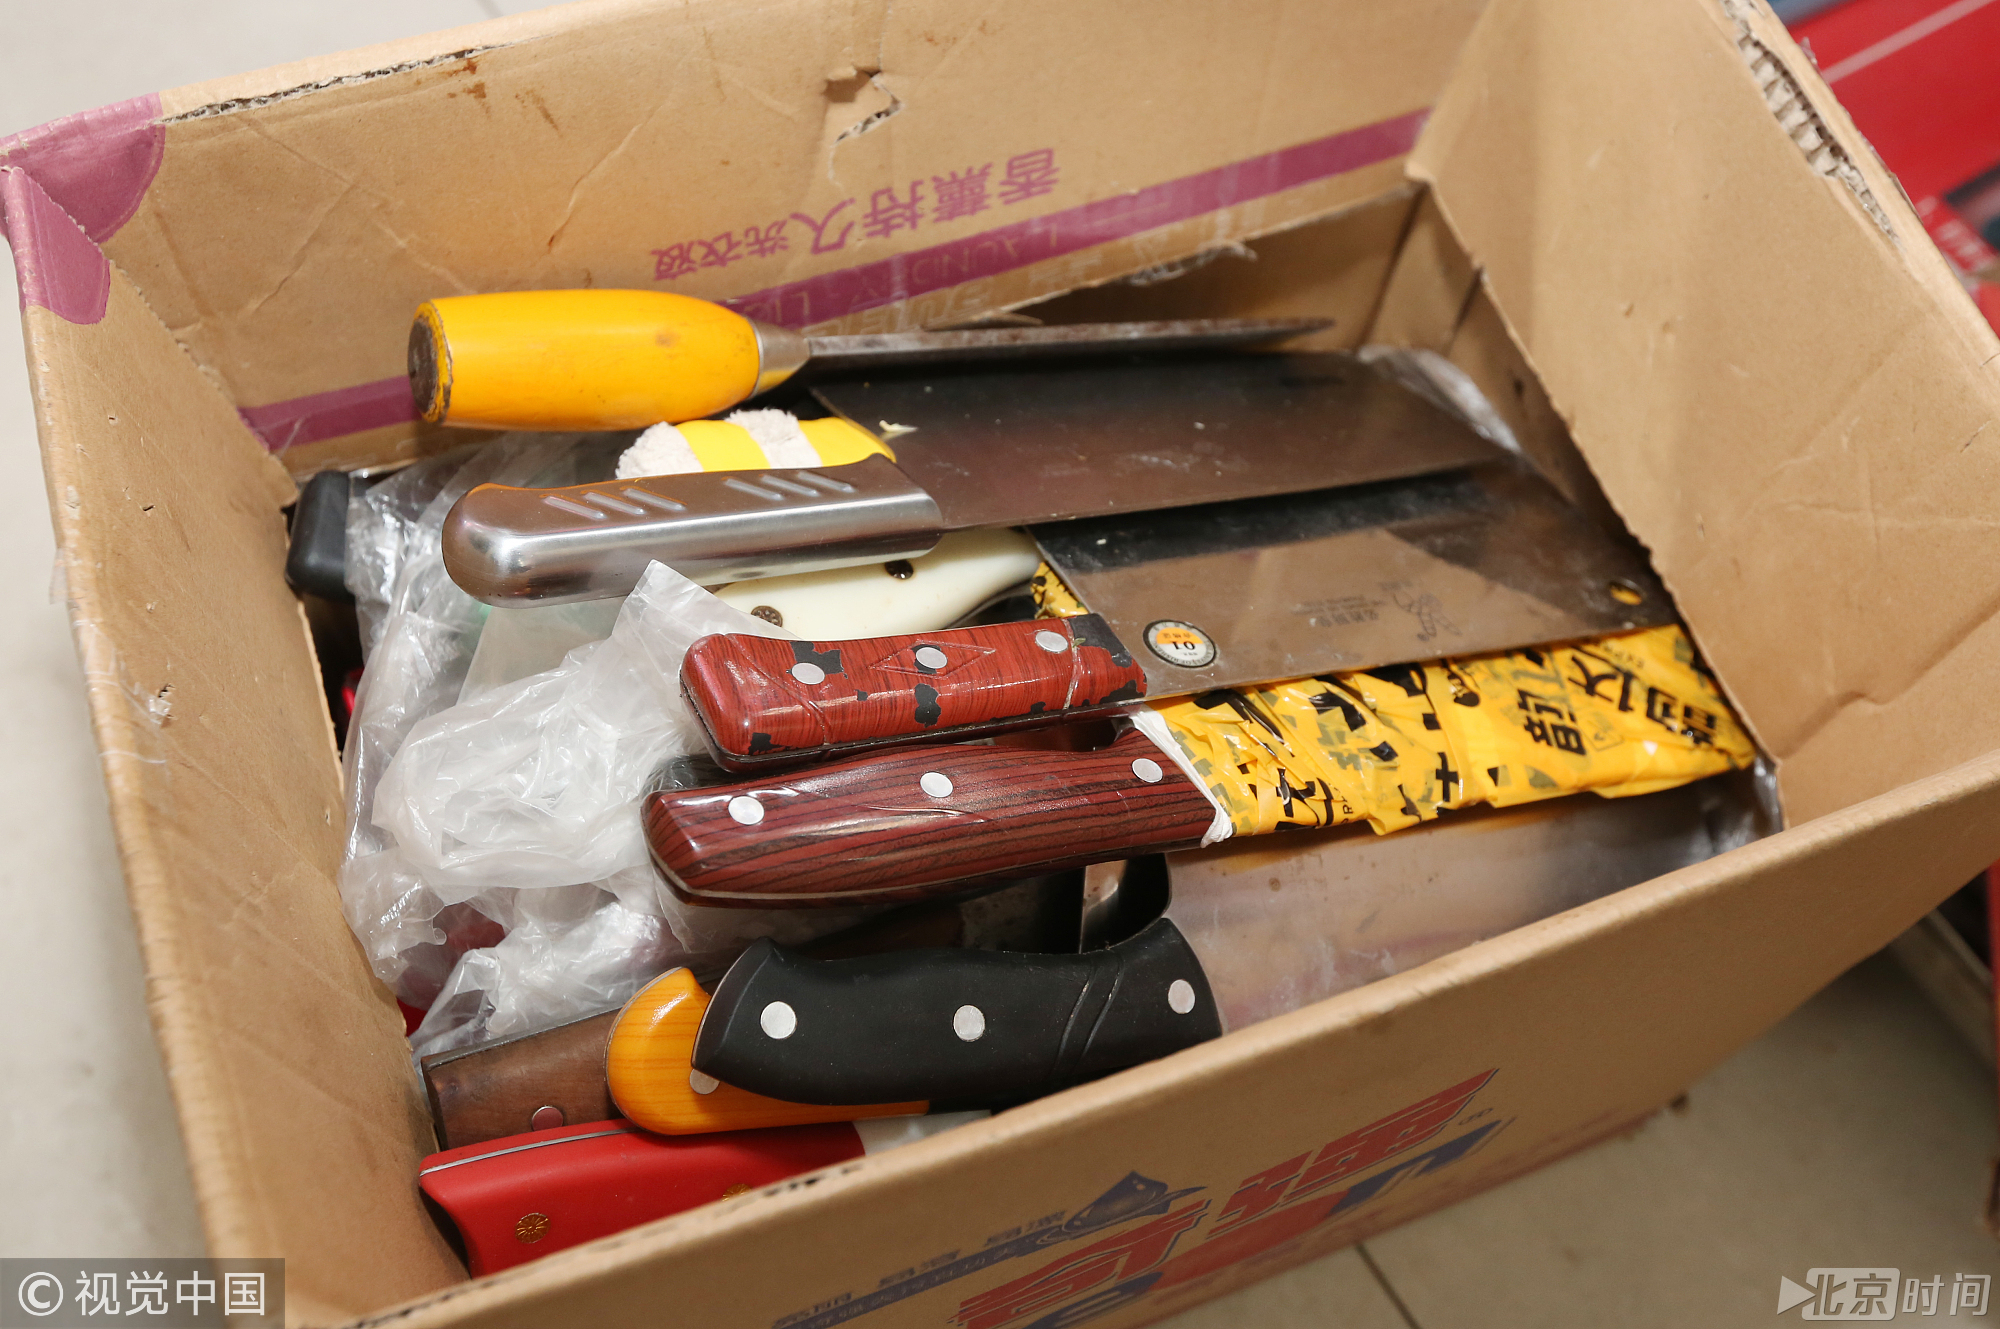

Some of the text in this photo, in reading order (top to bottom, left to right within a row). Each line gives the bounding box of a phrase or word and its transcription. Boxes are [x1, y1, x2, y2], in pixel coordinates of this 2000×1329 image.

[652, 148, 1060, 280] 香薰持久洗衣液
